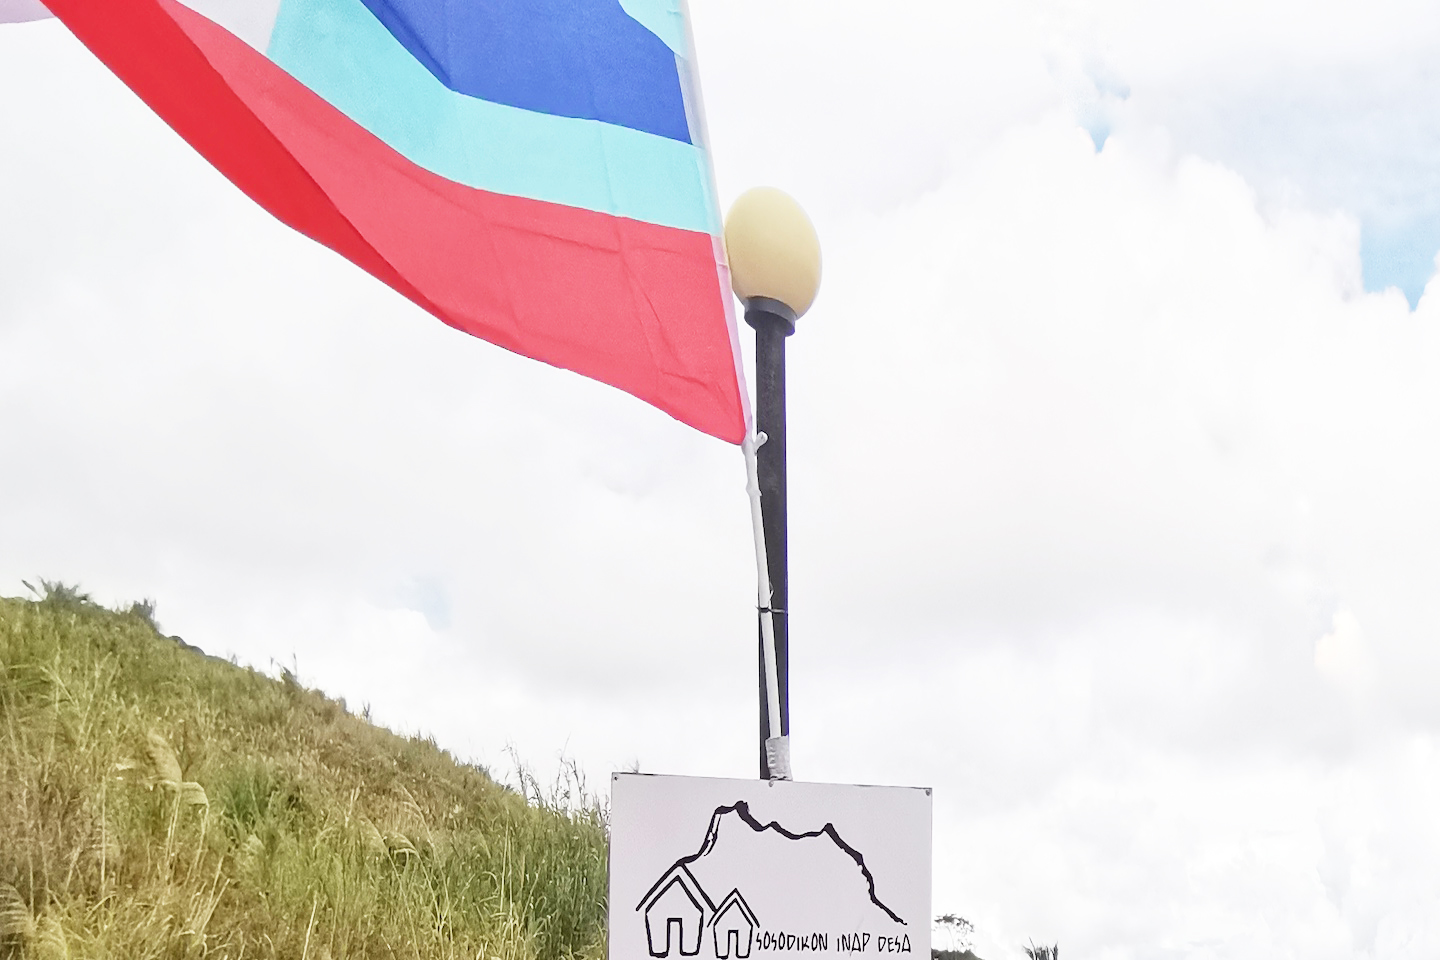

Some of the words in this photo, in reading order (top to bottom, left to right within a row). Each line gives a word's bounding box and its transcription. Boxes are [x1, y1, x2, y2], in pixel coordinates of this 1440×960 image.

[756, 931, 828, 951] SOSODIKON
[837, 932, 870, 952] INAP
[878, 933, 911, 953] DESA
